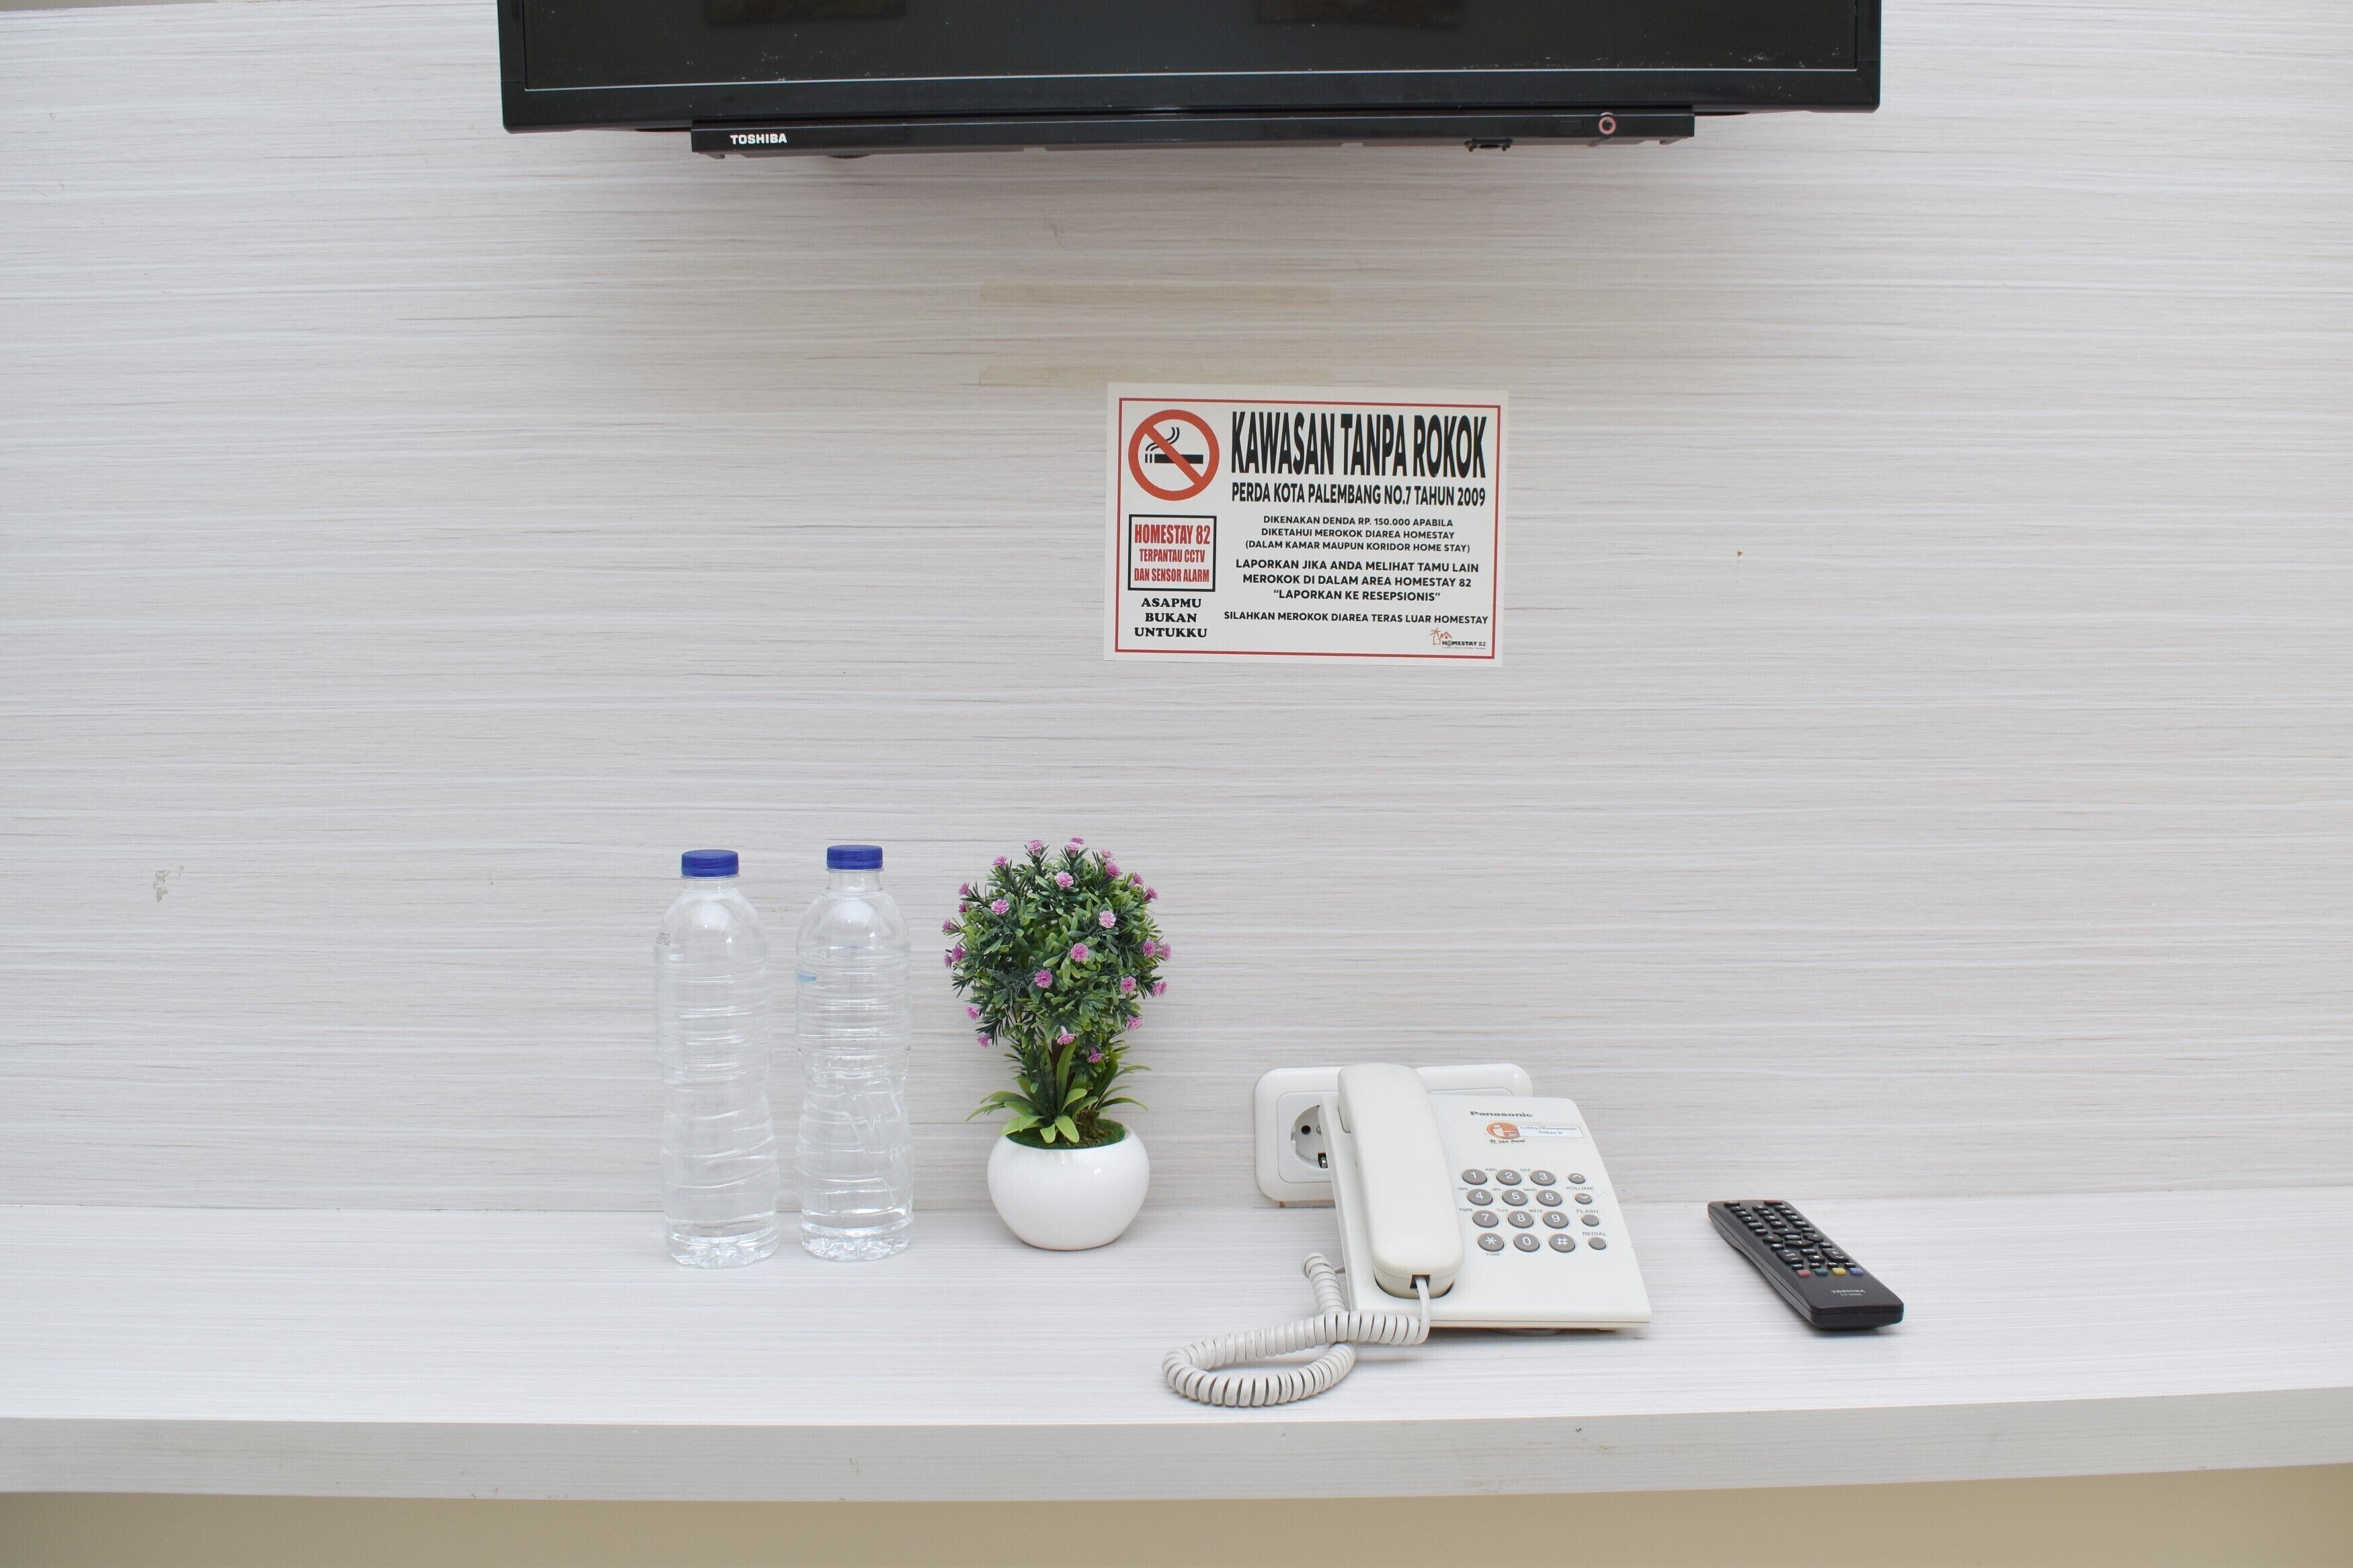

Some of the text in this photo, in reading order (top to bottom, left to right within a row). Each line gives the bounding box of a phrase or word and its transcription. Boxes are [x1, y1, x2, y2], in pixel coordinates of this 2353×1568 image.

[730, 133, 787, 145] TOSHIBA
[1232, 411, 1486, 478] KAWASAN TANPA ROKOK
[1232, 483, 1485, 506] PERDA KOTA PALEMBANG NO.7 TAHUN 2009
[1135, 524, 1210, 544] HOMESTAY 82
[1262, 528, 1312, 536] DIKETAHUI
[1404, 531, 1454, 539] HOMESTAY
[1246, 540, 1282, 549] (DALAM
[1323, 542, 1363, 550] MAUPUN
[1444, 544, 1470, 553] STAY)
[1140, 549, 1205, 563] TERPANTAU CCTV
[1236, 559, 1478, 572] LAPORKAN JIKA ANDA MELIHAT TAMU LAIN
[1135, 569, 1209, 582] DAN SENSOR ALARM
[1243, 575, 1471, 587] MEROKOK DI DALAM AREA HOMESTAY 82
[1274, 590, 1440, 601] “LAPORKAN KE RESEPSIONIS”
[1141, 598, 1201, 608] ASAPMU
[1145, 613, 1197, 622] BUKAN
[1224, 612, 1275, 620] SILAHKAN
[1278, 612, 1328, 620] MEROKOK
[1435, 616, 1488, 624] HOMESTAY
[1135, 628, 1207, 637] UNTUKKU
[1505, 1171, 1513, 1180] 2
[1539, 1172, 1548, 1180] 3
[1475, 1191, 1484, 1199] 4
[1511, 1192, 1520, 1200] 5
[1546, 1192, 1554, 1200] 6
[1481, 1213, 1489, 1221] 7
[1517, 1213, 1525, 1222] 8
[1552, 1214, 1560, 1223] 9
[1522, 1236, 1531, 1245] 0
